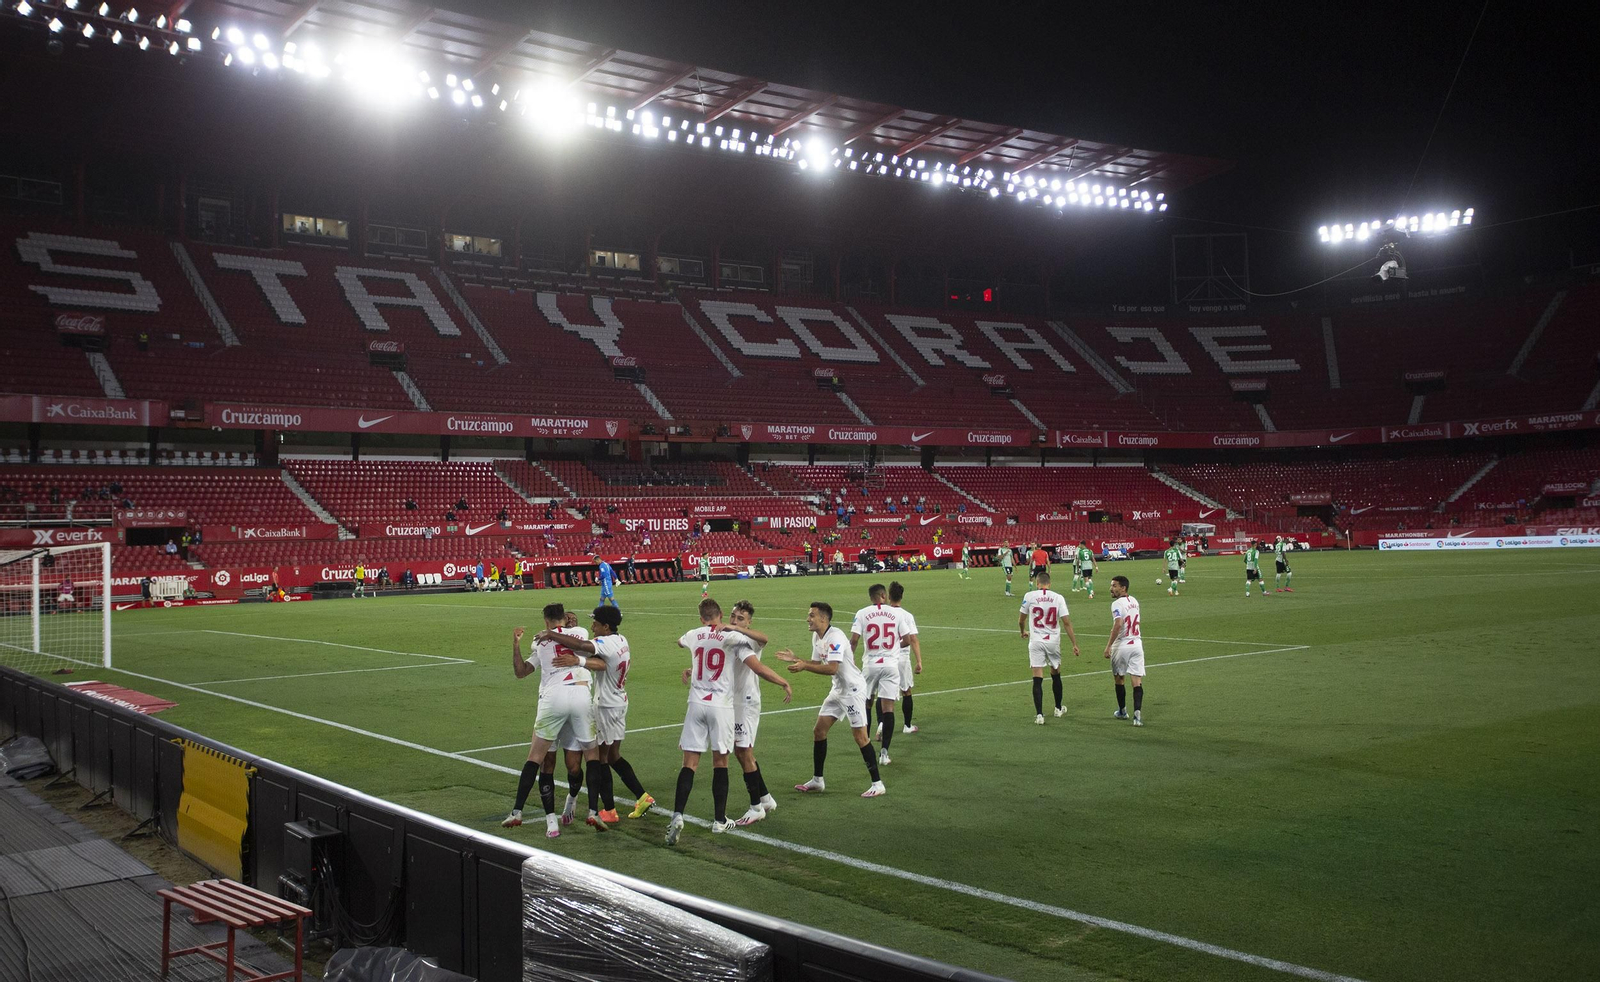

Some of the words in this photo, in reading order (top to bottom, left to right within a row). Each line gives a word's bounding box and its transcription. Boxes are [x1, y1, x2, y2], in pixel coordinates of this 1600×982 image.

[1112, 304, 1118, 312] Y
[1127, 305, 1137, 314] por
[1153, 305, 1165, 314] que
[1189, 304, 1201, 313] hoy
[1202, 305, 1222, 313] vengo
[536, 292, 624, 357] Y
[67, 404, 137, 420] CaixaBank
[221, 408, 302, 427] Cruzcampo
[447, 416, 514, 434] Cruzcampo
[531, 417, 589, 428] MARATHON
[1528, 413, 1583, 425] MARATHON
[767, 425, 815, 434] MARATHON
[1481, 419, 1518, 432] everfx
[828, 428, 878, 442] Cruzcampo
[967, 432, 1012, 445] Cruzcampo
[1070, 434, 1103, 444] CaixaBank
[1401, 428, 1443, 438] CaixaBank
[1118, 434, 1158, 446] Cruzcampo
[1213, 435, 1260, 446] Cruzcampo
[1141, 510, 1161, 519] everfx
[647, 518, 660, 531] TU
[663, 518, 689, 531] ERES
[770, 517, 781, 528] MI
[784, 516, 817, 528] PASION
[56, 528, 103, 541] everfx
[257, 527, 301, 538] CaixaBank
[1083, 551, 1090, 560] 5
[1167, 552, 1177, 561] 24
[240, 574, 269, 584] LaLiga
[865, 611, 896, 621] FERNANDO
[1032, 606, 1057, 629] 24
[1125, 614, 1140, 637] 16
[707, 632, 725, 641] JONG
[866, 623, 896, 650] 25
[694, 646, 726, 682] 19
